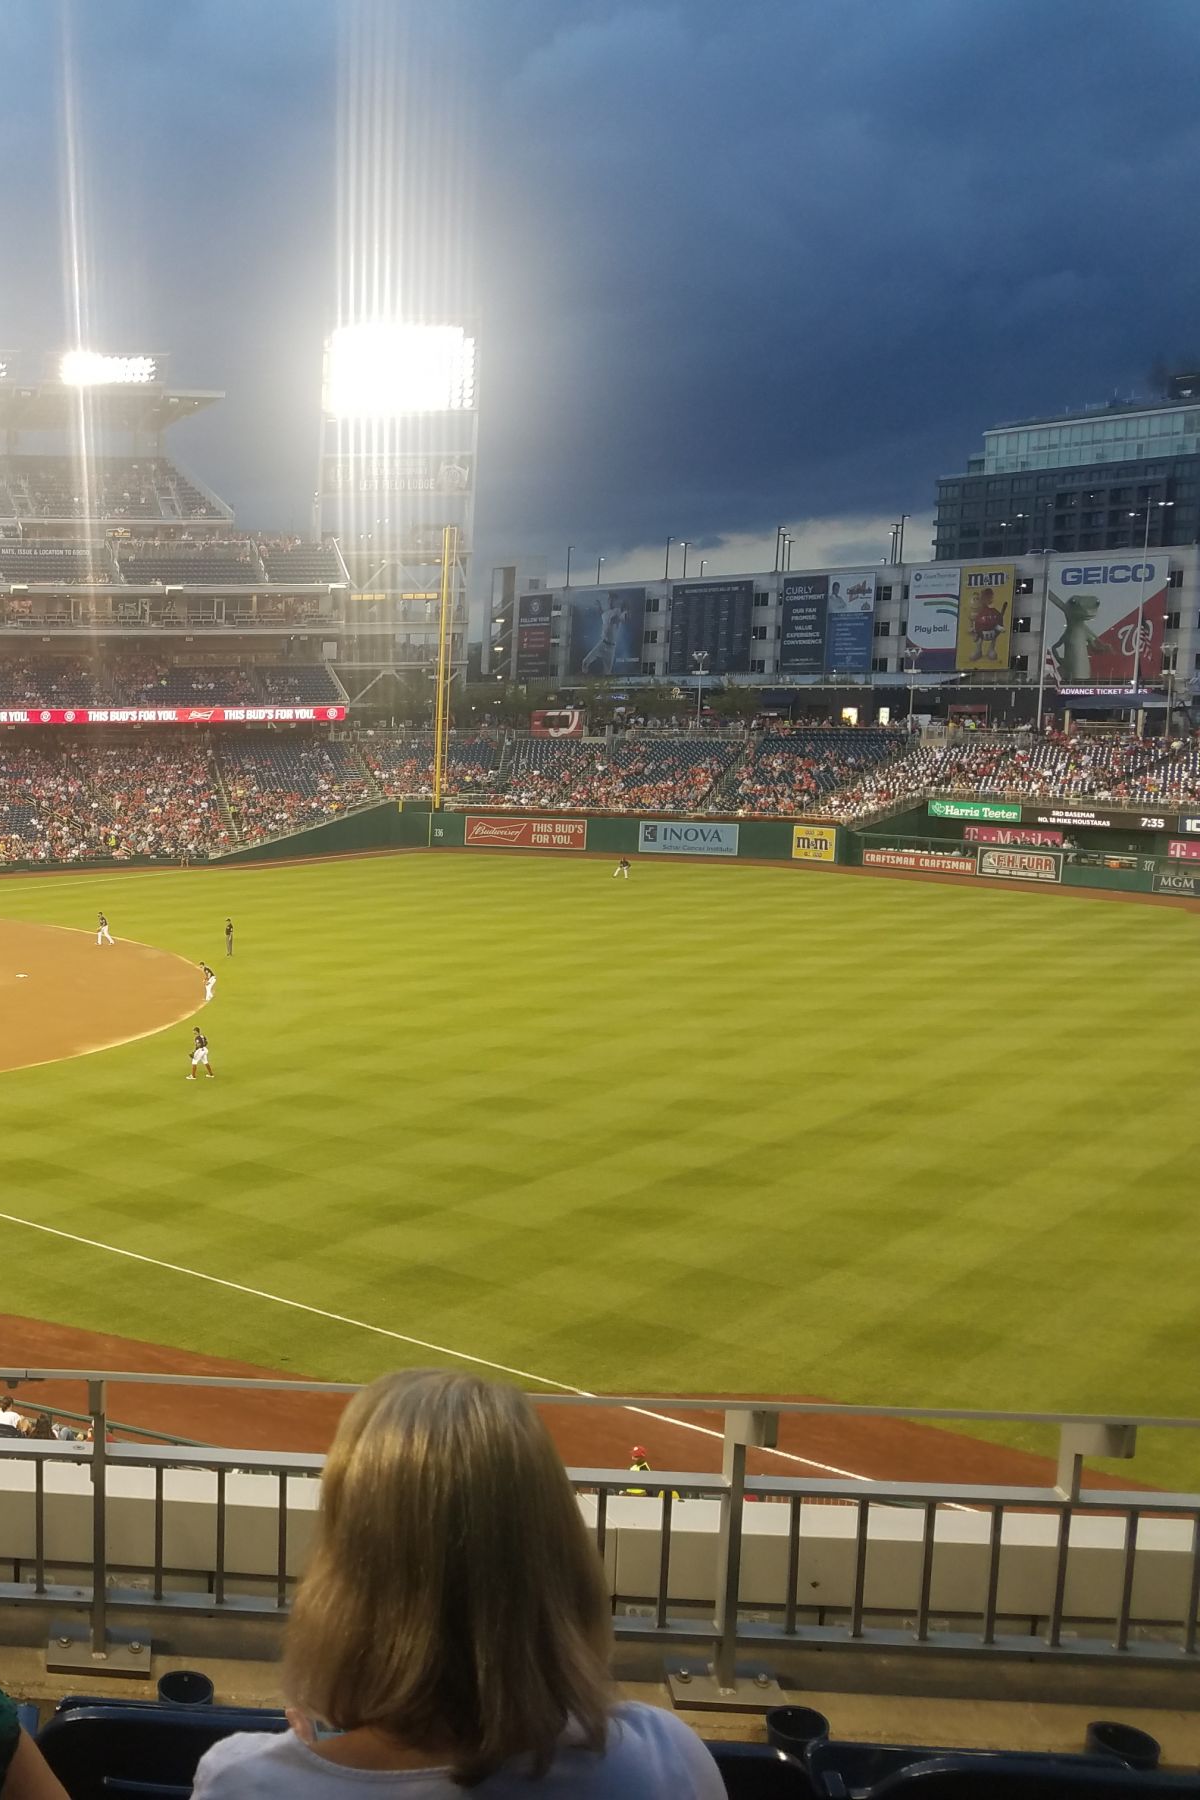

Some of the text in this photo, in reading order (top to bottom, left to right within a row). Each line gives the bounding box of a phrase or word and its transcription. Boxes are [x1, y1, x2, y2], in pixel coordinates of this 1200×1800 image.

[1061, 563, 1155, 586] GEICO
[785, 586, 813, 596] CURLY
[785, 593, 825, 602] COMMITMENT
[914, 625, 932, 635] Play
[1061, 688, 1148, 696] ADVANCE TICKET SAES
[8, 711, 29, 722] YOU.
[88, 711, 108, 721] THIS
[109, 711, 137, 721] BUD'S
[138, 711, 156, 721] FOR
[157, 711, 178, 721] YOU.
[224, 709, 245, 720] THIS
[246, 709, 274, 720] BUD'S
[275, 709, 293, 720] FOR
[294, 709, 316, 720] YOU.
[945, 805, 1018, 819] Harris Teeter
[1064, 811, 1095, 819] BASEMAN
[531, 822, 584, 834] THIS BUD'S
[1072, 819, 1111, 827] MOUSTAKAS
[1141, 817, 1165, 828] 7:35
[473, 823, 521, 836] Budweiser
[663, 827, 723, 843] INOVA
[531, 834, 573, 846] FOR YOU.
[682, 844, 705, 852] Cancer
[706, 845, 734, 854] Institute
[865, 853, 973, 870] CRAFTSMAN CRAFTSMAN
[1020, 857, 1053, 871] FURR
[1160, 876, 1194, 889] MGM
